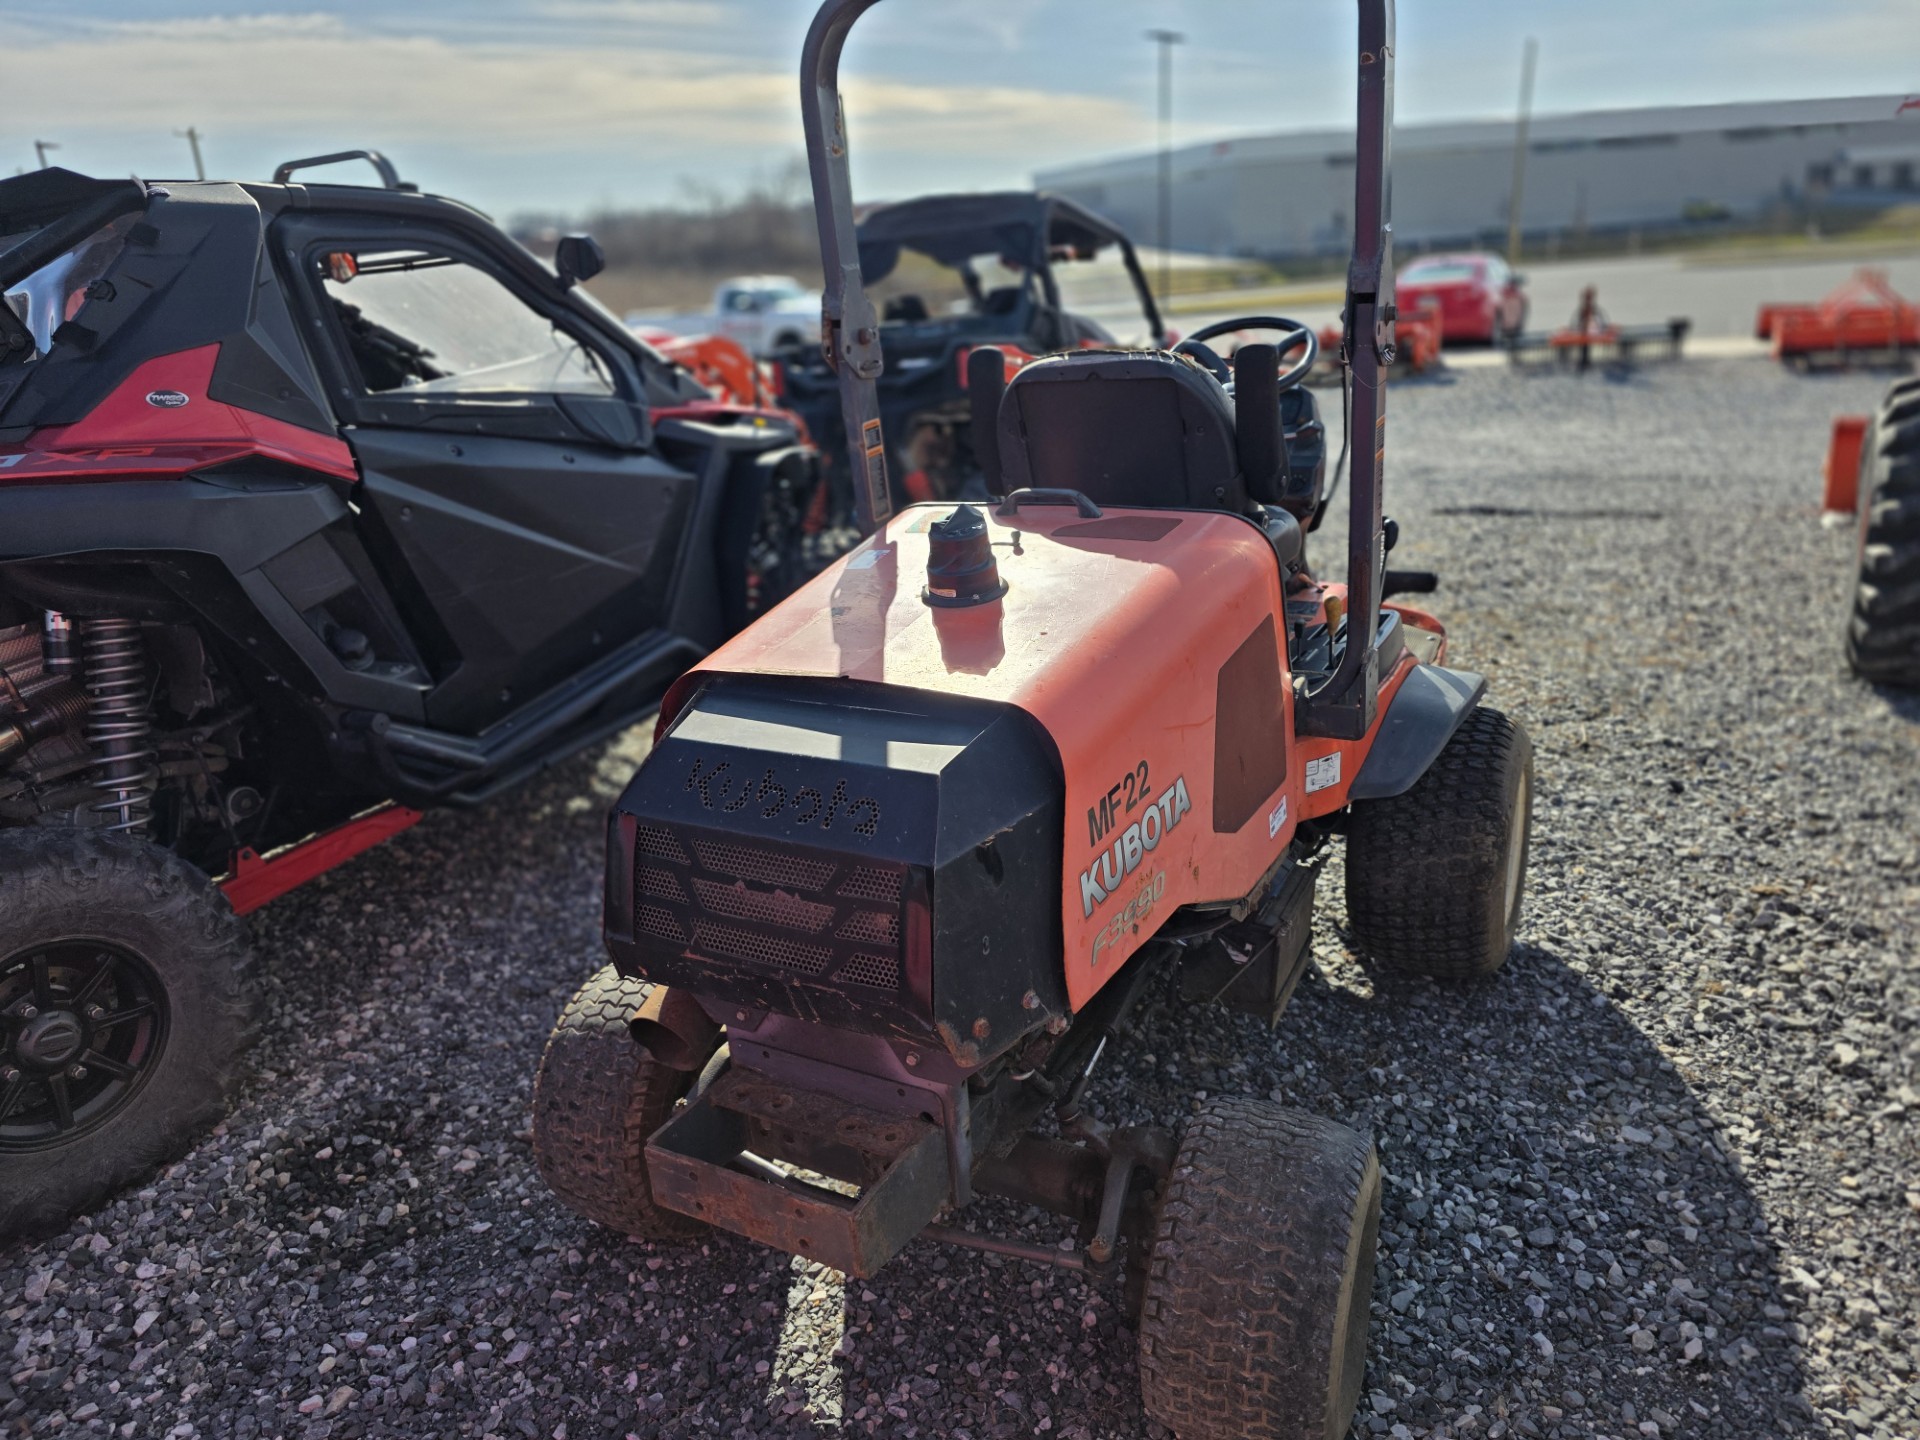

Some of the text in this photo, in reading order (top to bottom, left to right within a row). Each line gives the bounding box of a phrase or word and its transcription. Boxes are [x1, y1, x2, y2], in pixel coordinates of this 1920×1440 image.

[30, 447, 156, 466] XP
[684, 757, 880, 837] Kubota
[1080, 775, 1191, 920] KUBOTA
